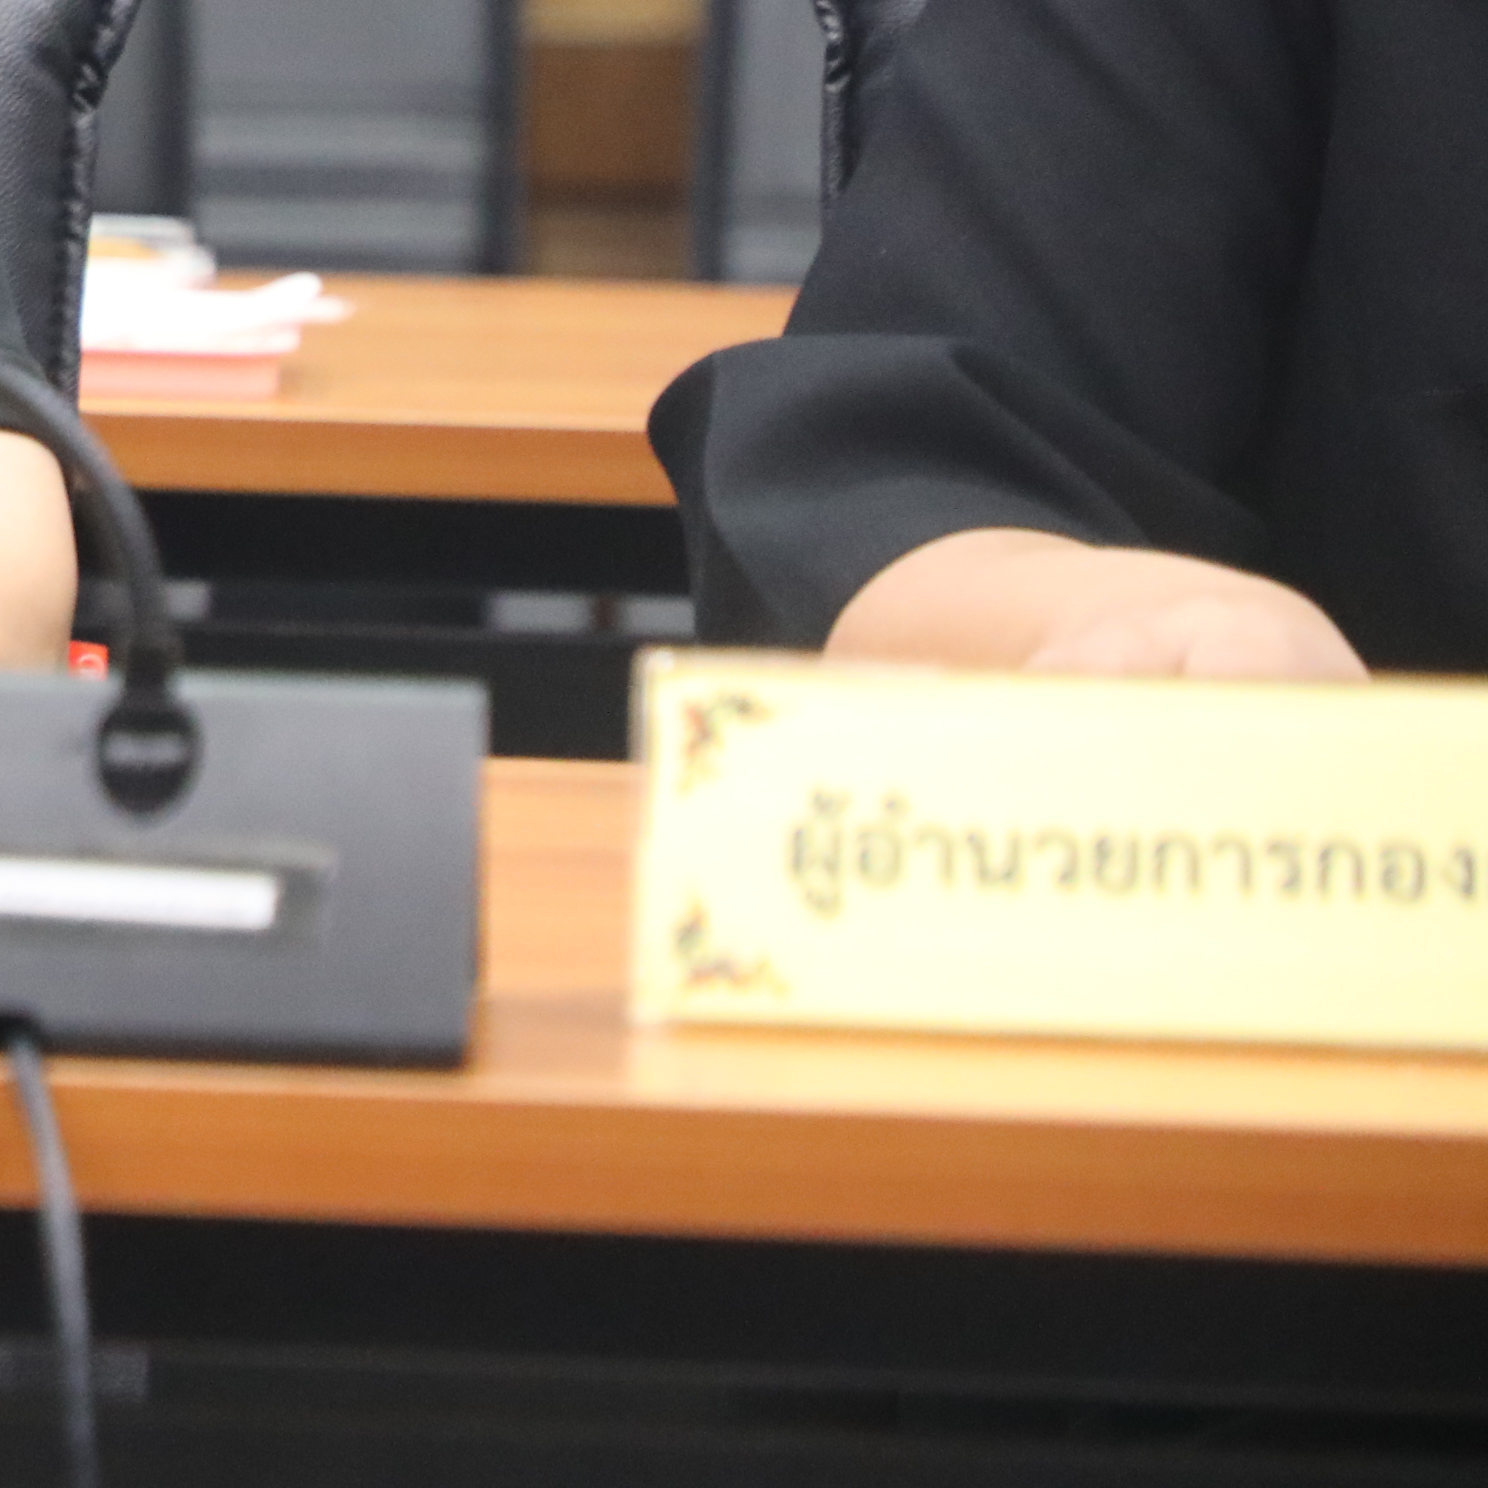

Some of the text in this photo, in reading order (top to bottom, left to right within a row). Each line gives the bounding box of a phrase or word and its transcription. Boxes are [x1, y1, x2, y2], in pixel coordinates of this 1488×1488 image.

[787, 788, 1482, 918] ผู้อำนวยการกอง
